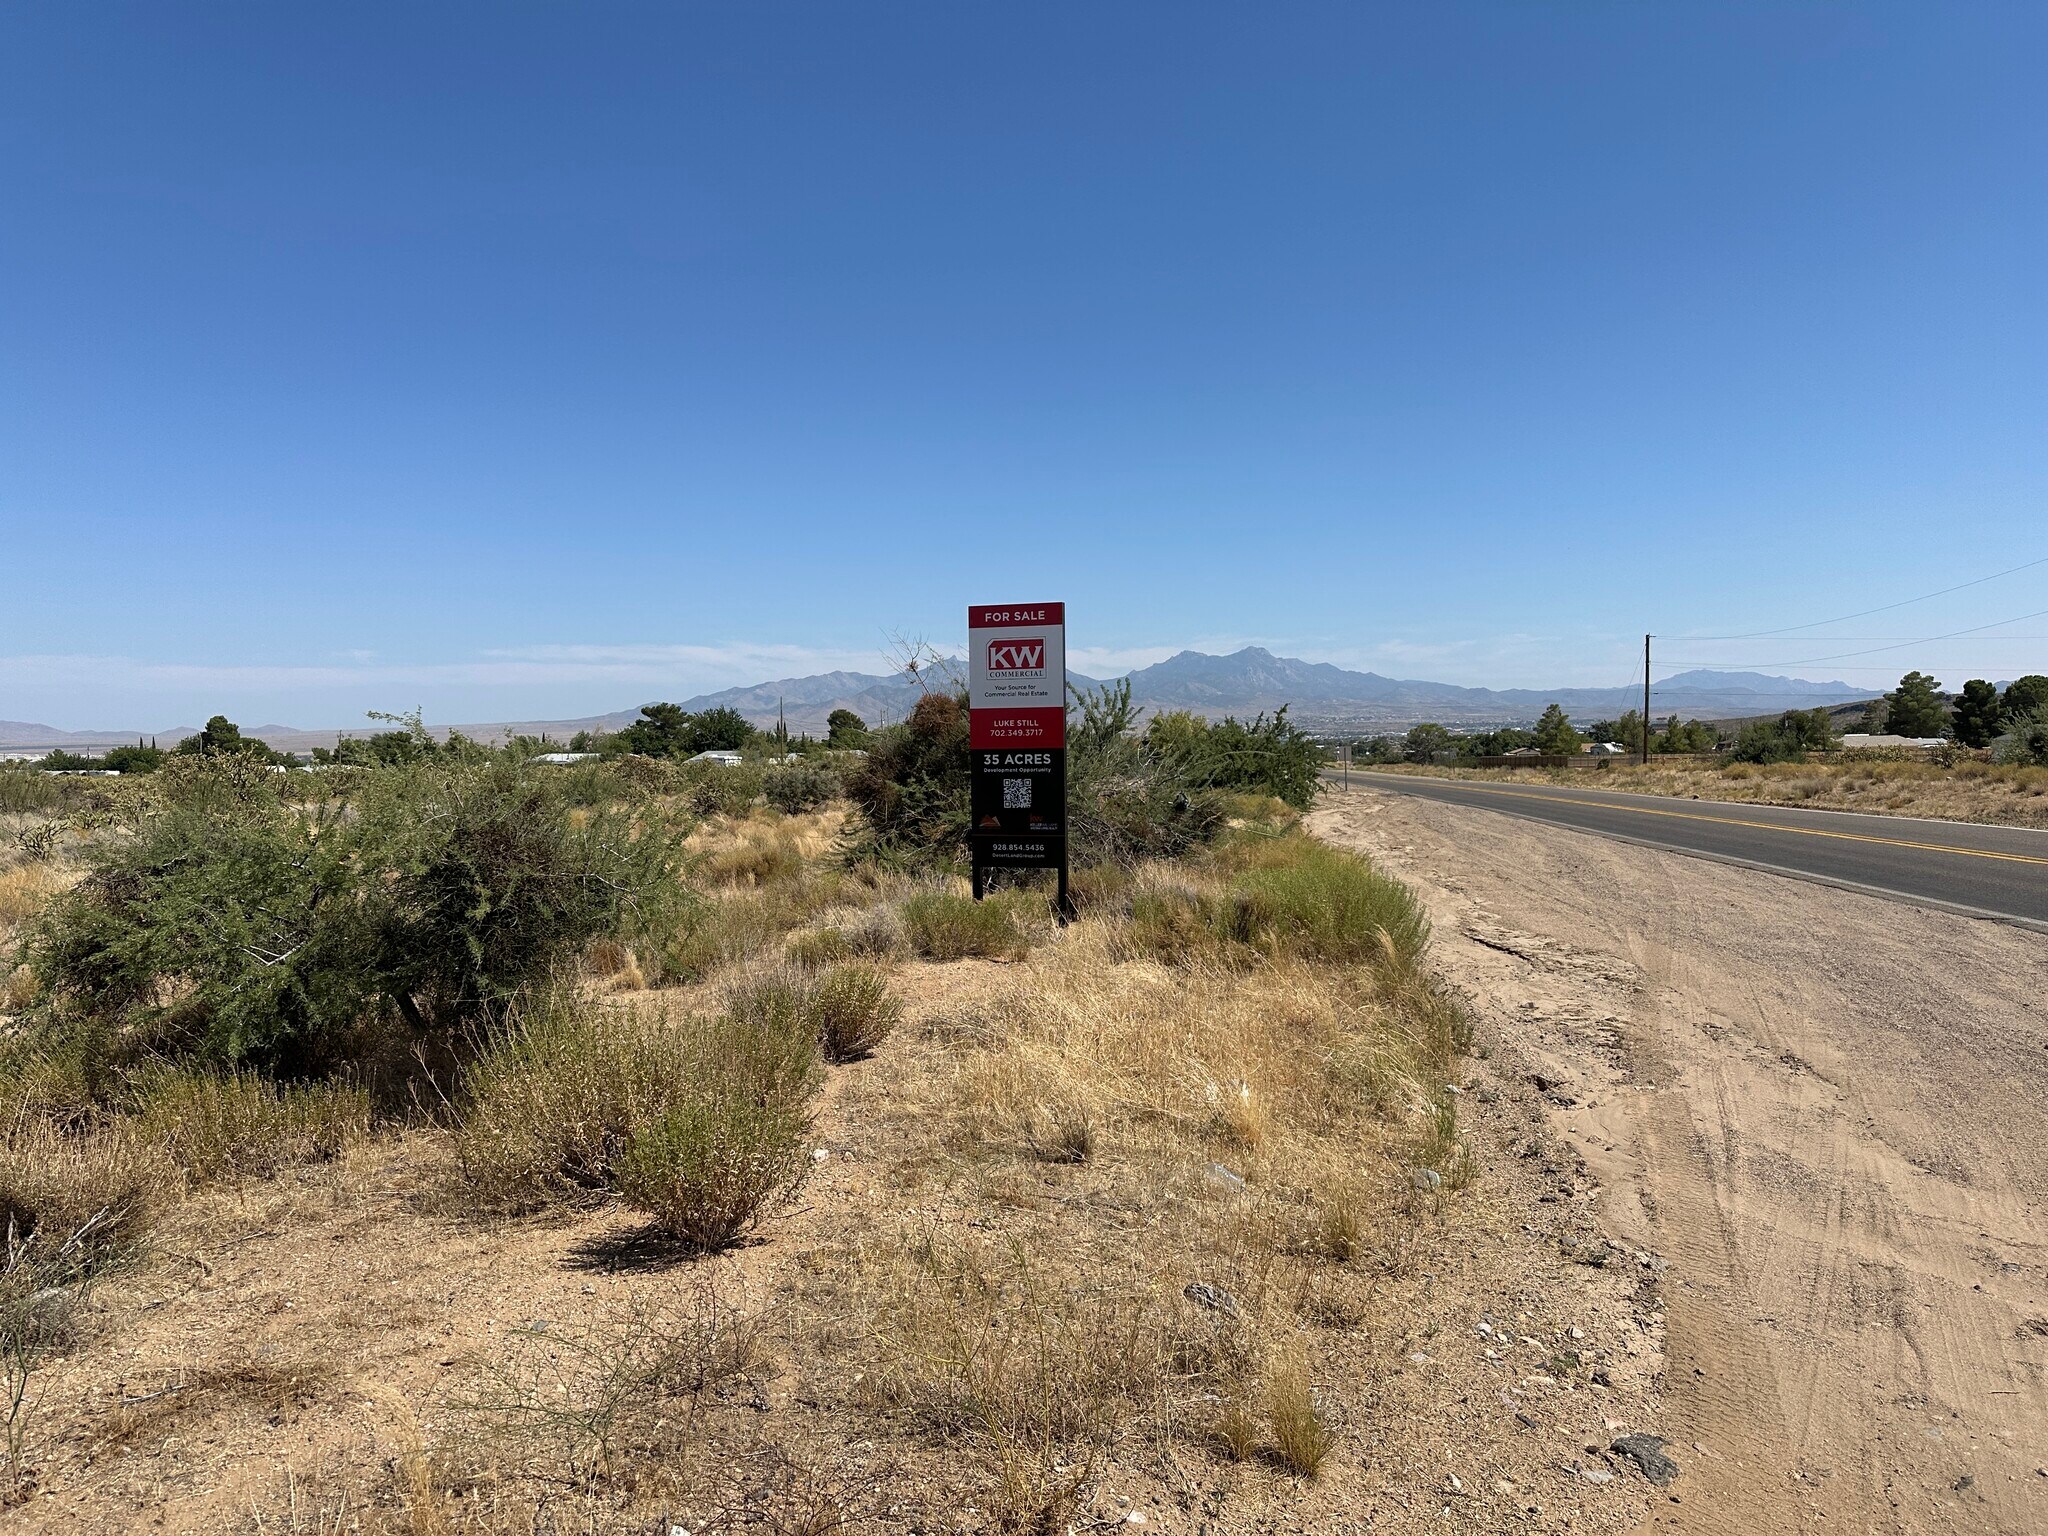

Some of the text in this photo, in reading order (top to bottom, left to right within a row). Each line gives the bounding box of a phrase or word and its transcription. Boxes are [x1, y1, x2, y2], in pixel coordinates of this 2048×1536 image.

[985, 611, 1045, 622] FOR SALE
[990, 645, 1043, 669] KW
[989, 670, 1043, 678] COMMERCIAL
[1017, 719, 1039, 727] STILL
[990, 729, 1043, 737] 702.349.3717
[983, 753, 1051, 765] 35 ACRES
[992, 843, 1045, 851] 928.854.5436
